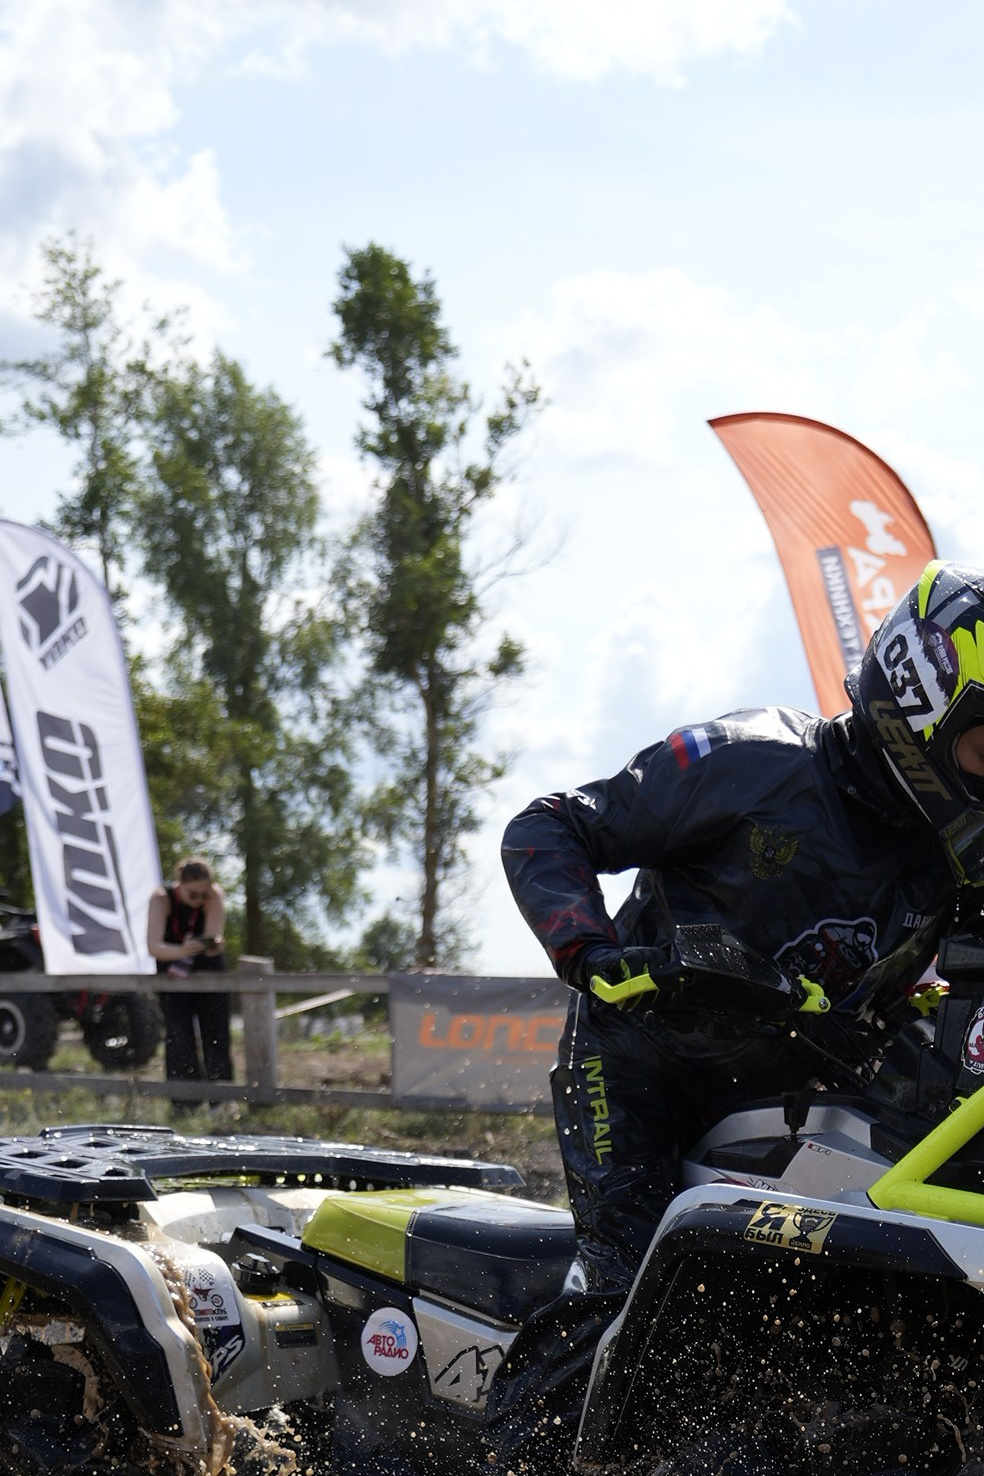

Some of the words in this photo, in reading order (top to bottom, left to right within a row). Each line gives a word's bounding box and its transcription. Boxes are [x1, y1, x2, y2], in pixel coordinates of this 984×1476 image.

[883, 633, 934, 718] 037
[869, 700, 953, 801] LEATT
[37, 710, 129, 955] YOKO
[744, 1227, 784, 1245] БЫЛ
[366, 1334, 395, 1347] АВТО
[373, 1345, 409, 1360] РАДИО
